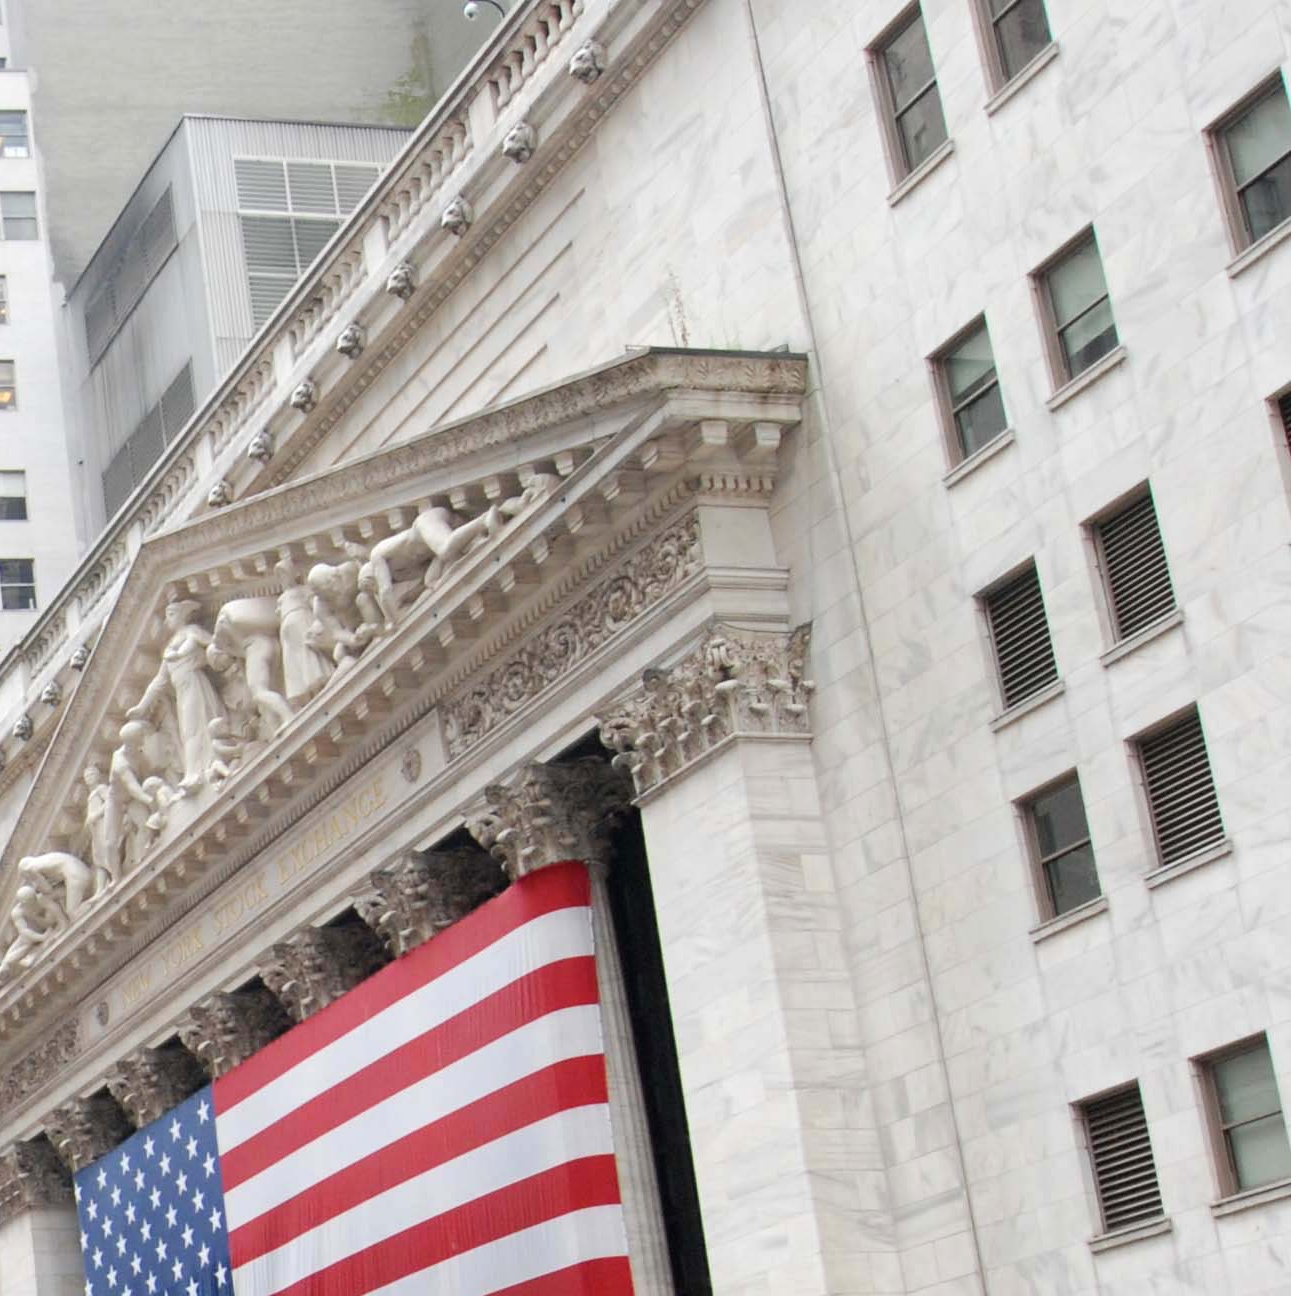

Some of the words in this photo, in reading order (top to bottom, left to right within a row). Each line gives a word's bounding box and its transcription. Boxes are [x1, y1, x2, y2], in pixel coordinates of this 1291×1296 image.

[121, 973, 152, 1005] NEW
[159, 927, 204, 977] YORK
[213, 874, 269, 936] STOCK
[276, 780, 387, 883] EXCHANGE
